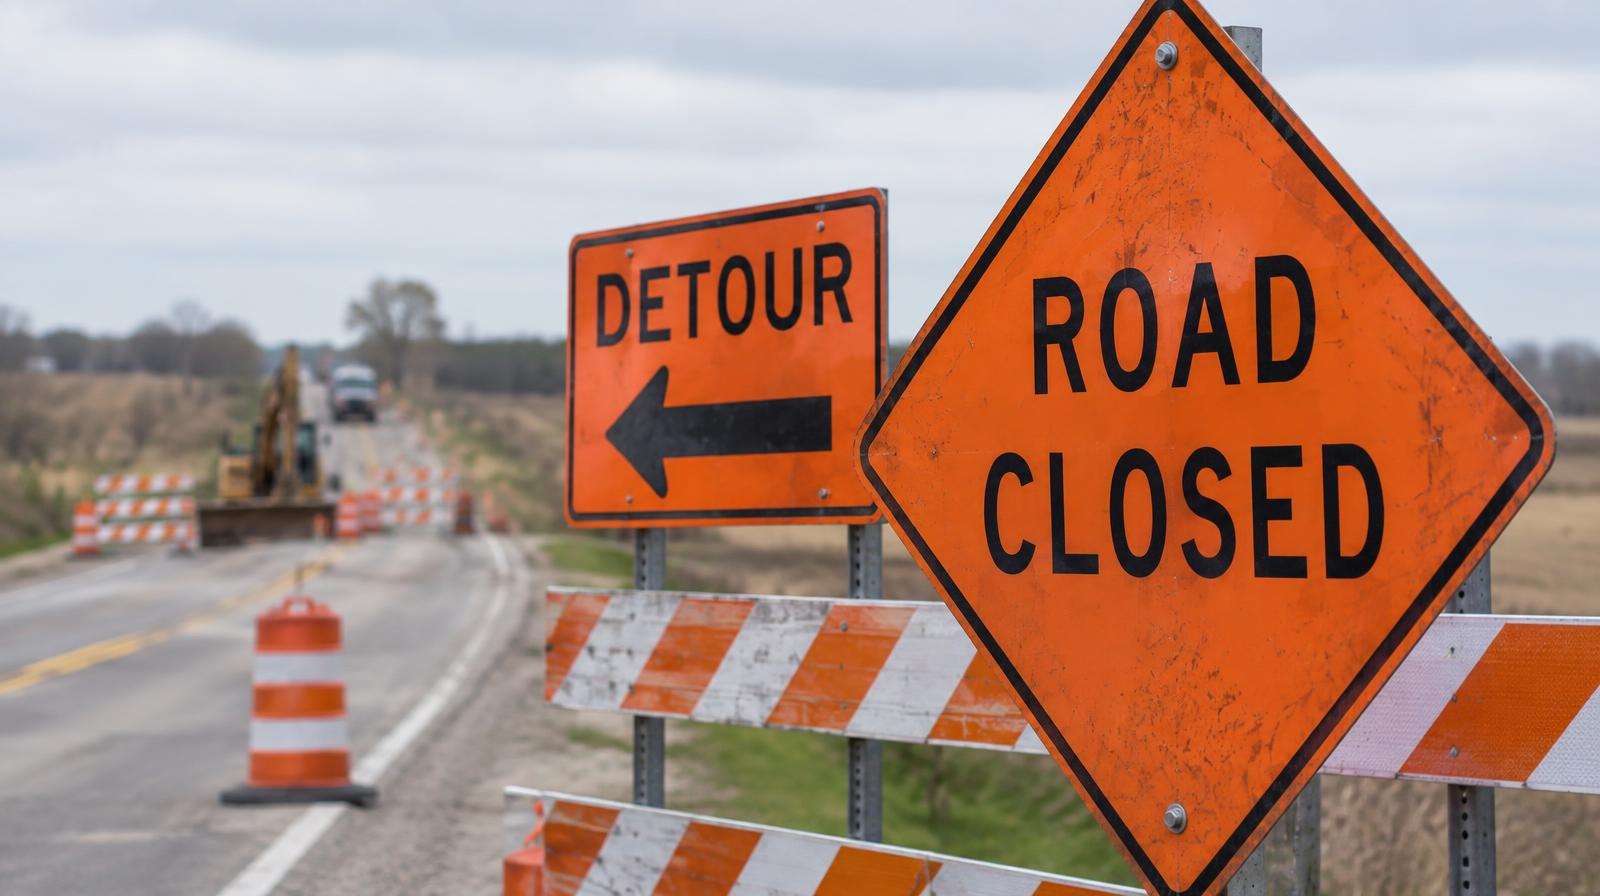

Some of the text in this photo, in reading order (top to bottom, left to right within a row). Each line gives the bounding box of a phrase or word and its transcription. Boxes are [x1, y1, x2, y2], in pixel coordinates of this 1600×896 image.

[596, 242, 853, 347] DETOUR
[1032, 254, 1316, 395] ROAD
[983, 442, 1385, 580] CLOSED
